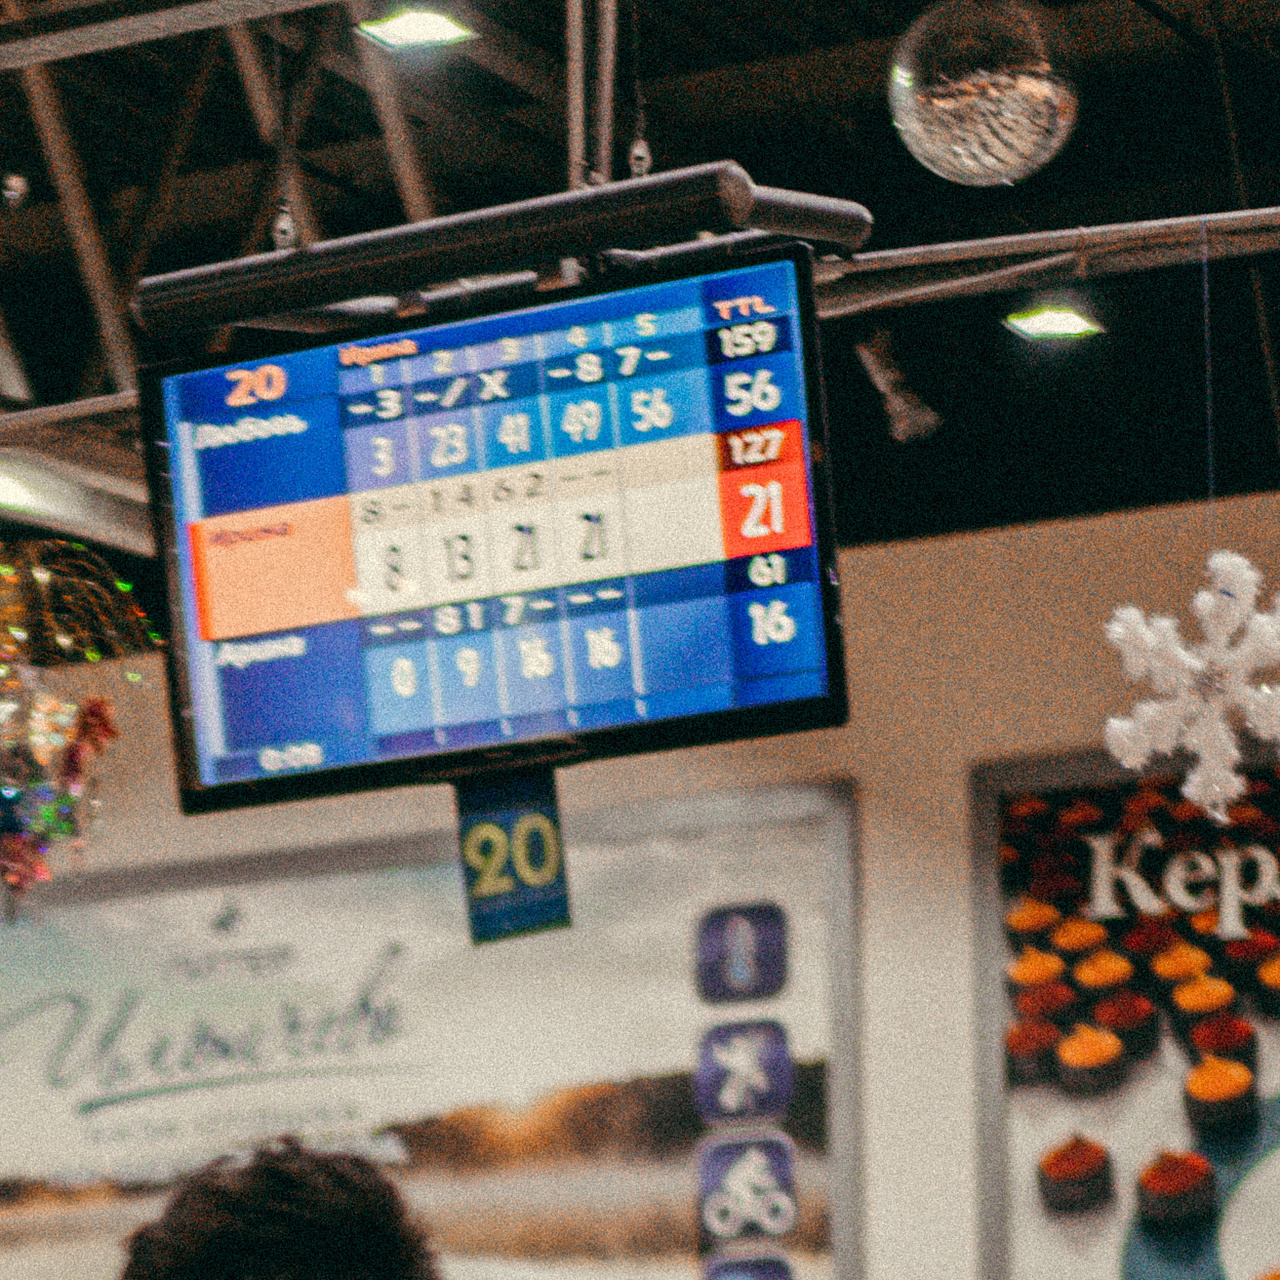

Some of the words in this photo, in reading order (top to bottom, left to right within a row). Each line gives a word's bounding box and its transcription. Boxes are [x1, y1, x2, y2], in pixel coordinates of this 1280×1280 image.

[714, 297, 777, 322] TTL
[370, 364, 386, 384] 1
[433, 351, 454, 374] 2
[501, 338, 521, 361] 3
[566, 326, 588, 348] 4
[634, 313, 657, 337] 5
[717, 322, 778, 357] 159
[224, 364, 288, 407] 20
[723, 372, 782, 415] 56
[371, 437, 394, 477] 3
[429, 424, 469, 466] 23
[561, 401, 602, 443] 49
[629, 390, 674, 431] 56
[726, 430, 785, 464] 127
[739, 483, 786, 539] 21
[748, 601, 797, 646] 16
[455, 648, 481, 688] 9
[463, 813, 561, 899] 20
